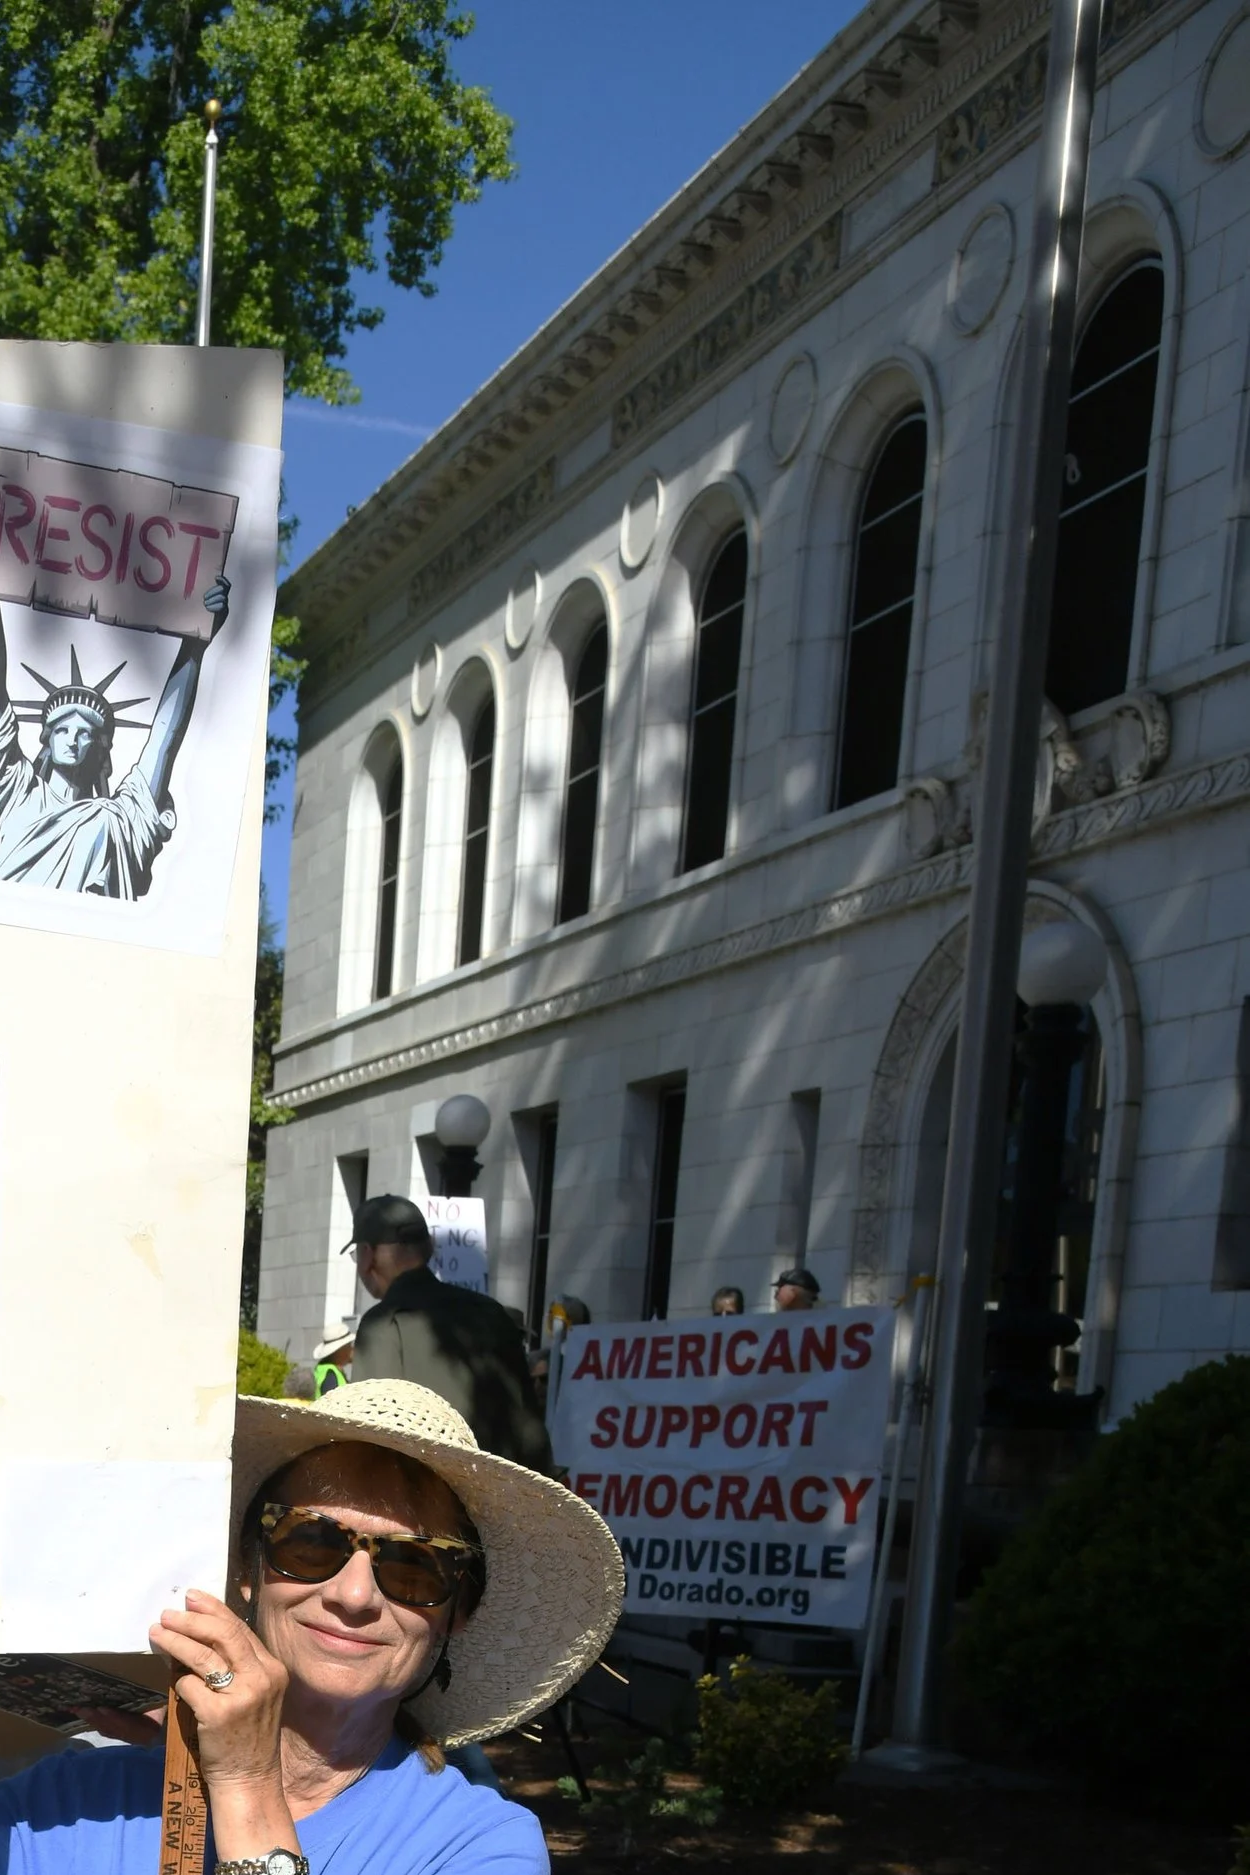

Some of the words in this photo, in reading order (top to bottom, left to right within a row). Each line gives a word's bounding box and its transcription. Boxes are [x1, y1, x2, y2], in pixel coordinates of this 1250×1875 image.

[427, 1200, 461, 1222] NO
[430, 1225, 478, 1249] ING
[571, 1322, 874, 1381] AMERICANS
[590, 1401, 829, 1449] SUPPORT
[621, 1537, 848, 1579] NDIVISIBLE
[638, 1573, 810, 1616] Dorado.org
[168, 1780, 183, 1794] A
[166, 1801, 183, 1850] NEW
